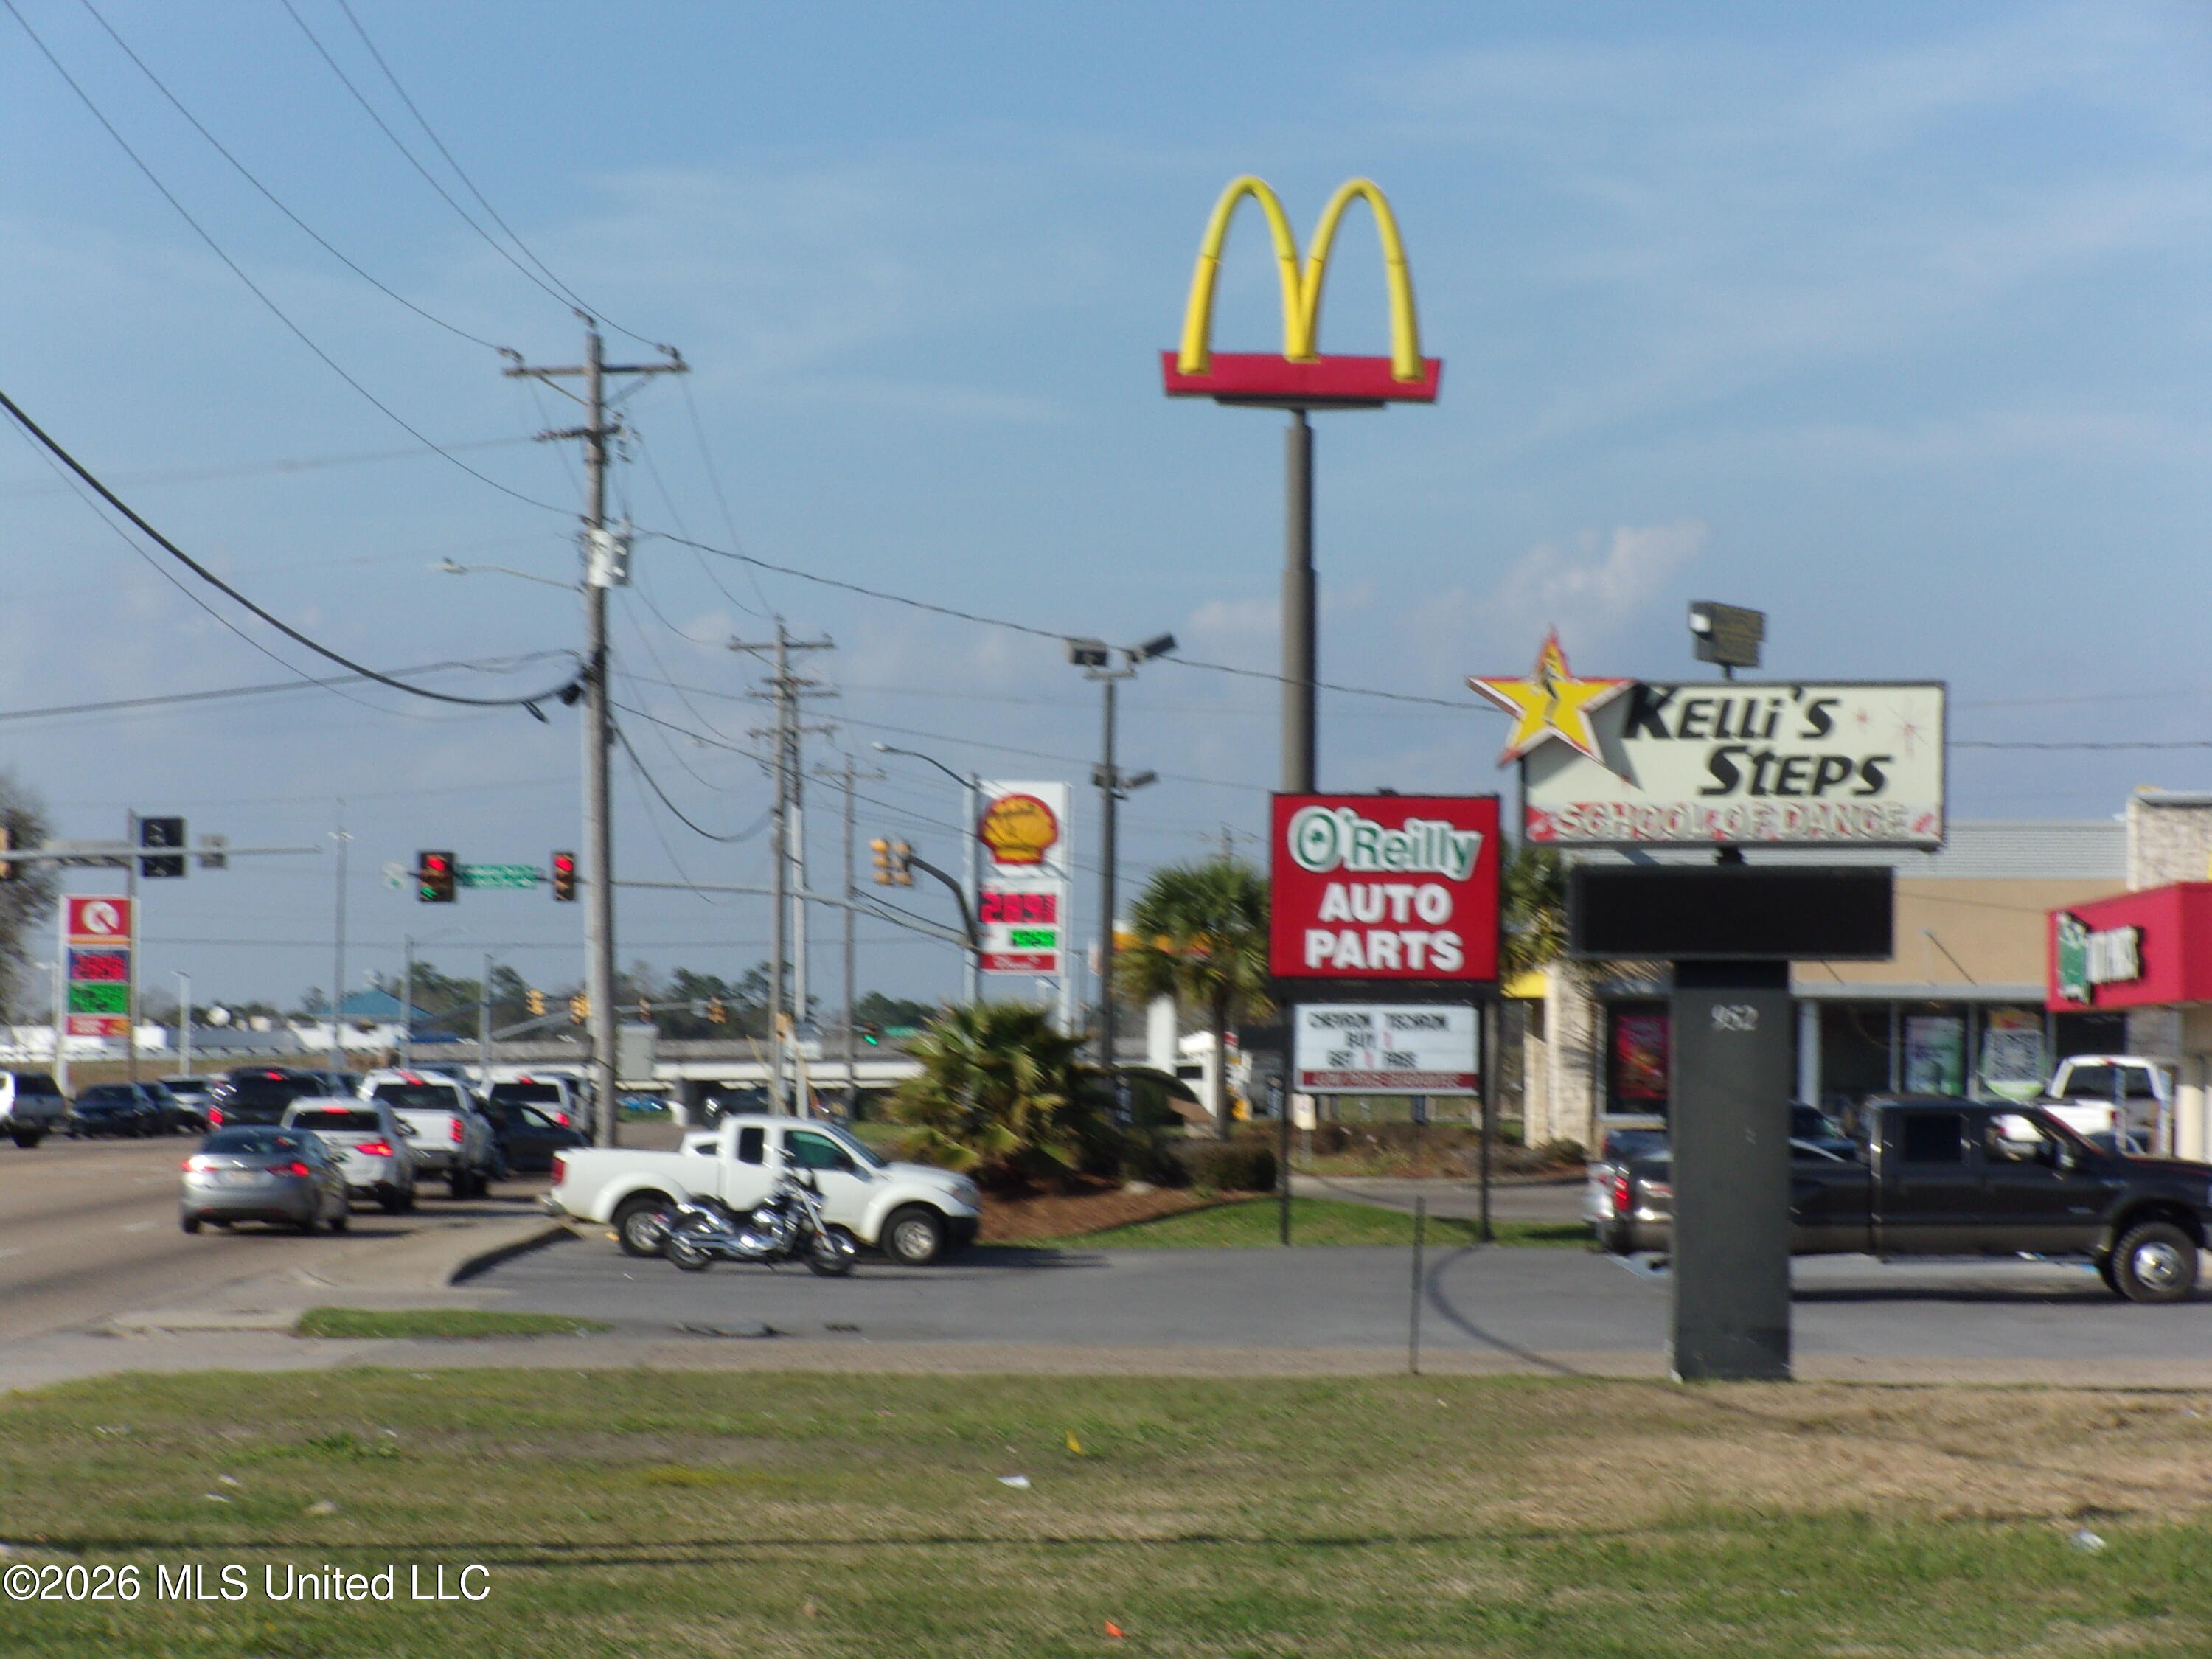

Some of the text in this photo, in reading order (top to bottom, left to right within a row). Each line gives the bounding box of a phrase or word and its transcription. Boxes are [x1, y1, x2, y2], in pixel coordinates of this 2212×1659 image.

[1557, 803, 1907, 839] SCHOOL OF DANCE
[1290, 807, 1481, 878] O'Reilly
[1318, 883, 1453, 925] AUTO
[1305, 929, 1464, 971] PARTS
